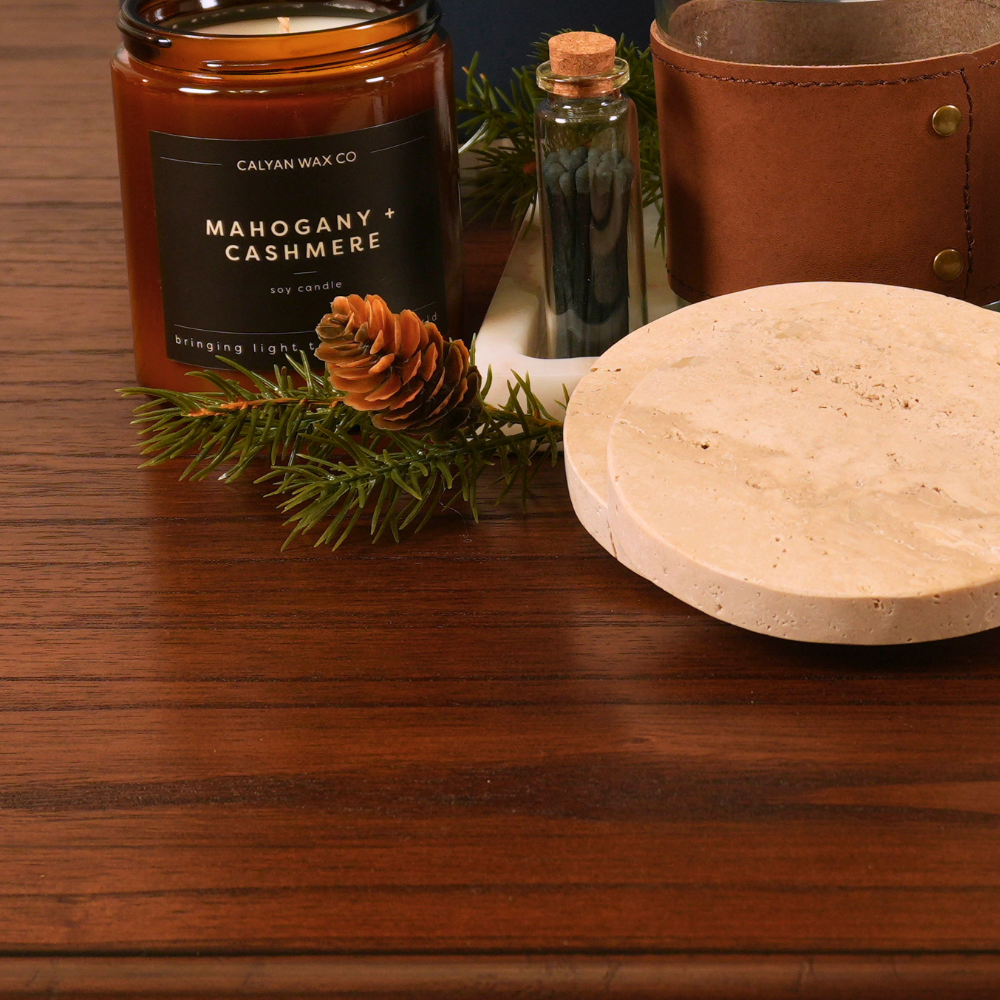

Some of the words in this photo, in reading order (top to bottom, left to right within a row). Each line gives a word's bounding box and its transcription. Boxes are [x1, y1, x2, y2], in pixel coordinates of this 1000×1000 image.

[236, 158, 294, 171] CALYAN
[298, 154, 332, 169] WAX
[335, 151, 357, 164] CO
[206, 209, 372, 237] MAHOGANY
[384, 207, 395, 219] +
[225, 232, 381, 262] CASHMERE
[270, 285, 292, 295] soy
[297, 280, 343, 293] candle
[175, 334, 242, 354] bringing
[253, 343, 298, 355] light
